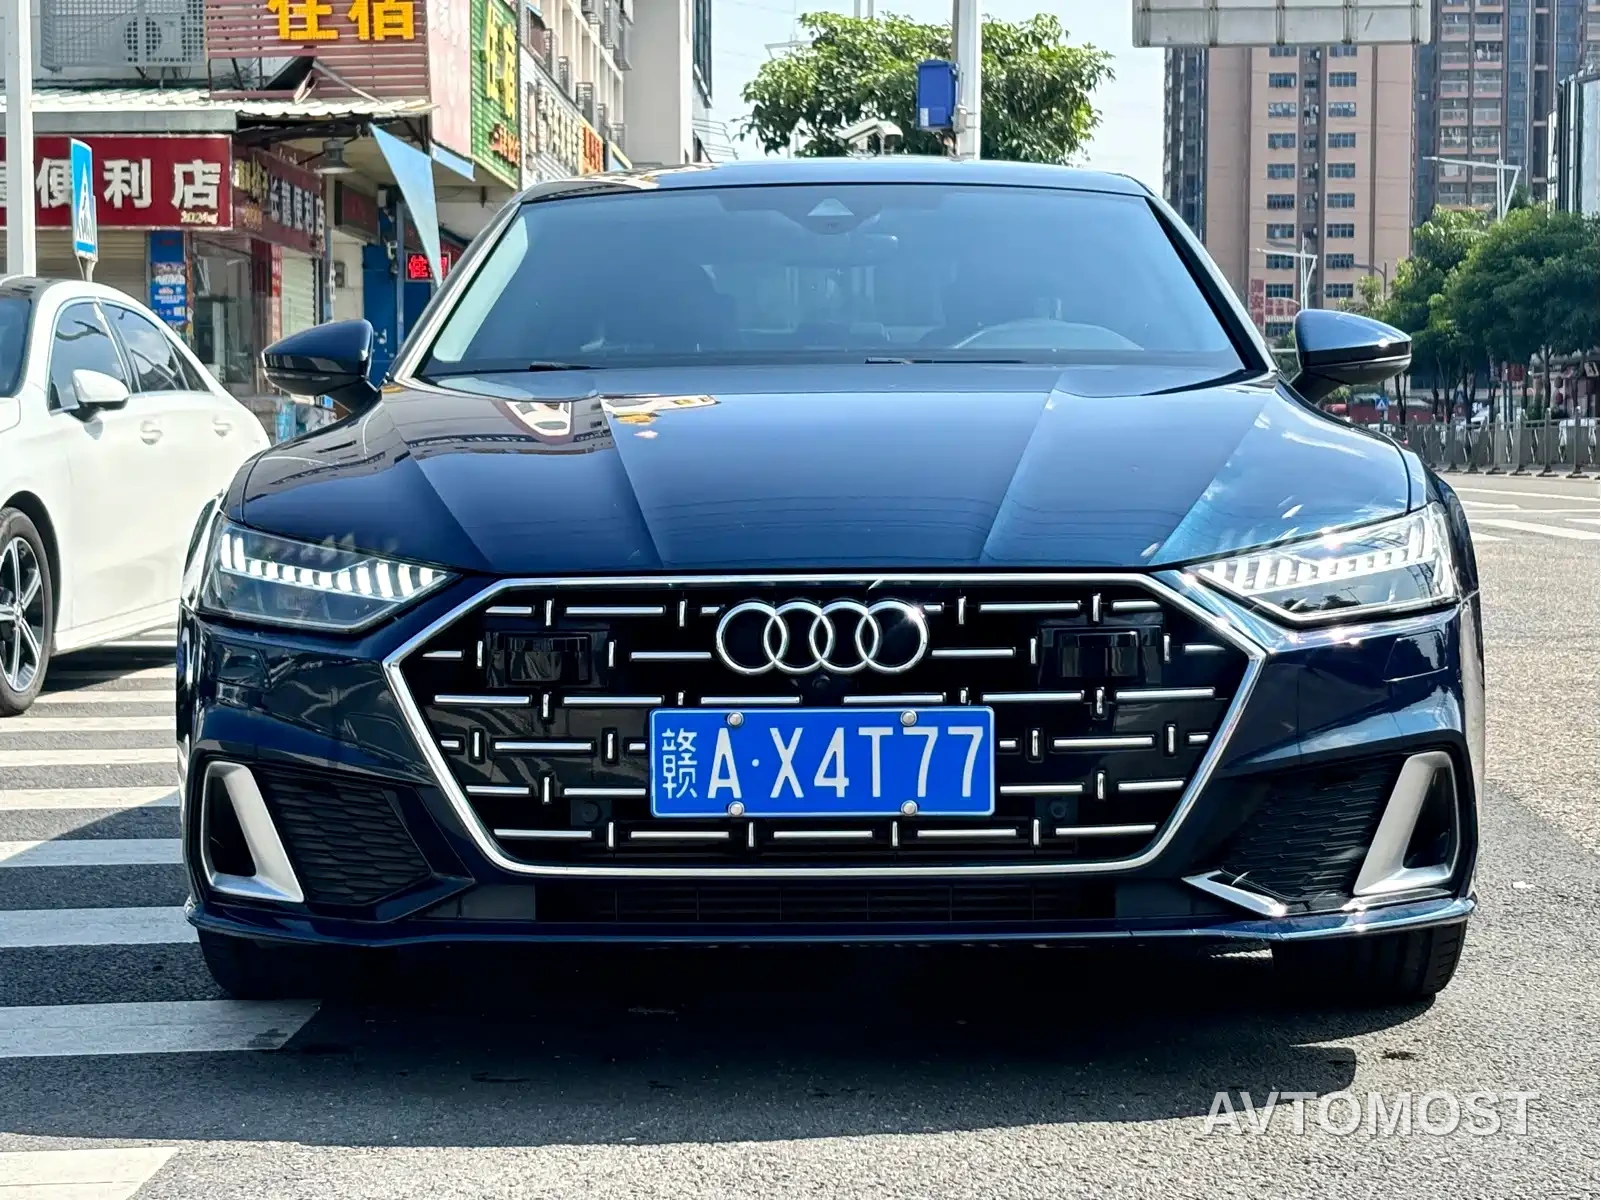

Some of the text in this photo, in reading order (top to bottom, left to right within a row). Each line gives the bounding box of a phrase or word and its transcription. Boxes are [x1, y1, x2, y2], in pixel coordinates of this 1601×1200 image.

[267, 0, 415, 41] 住宿
[0, 157, 222, 209] 便利店
[661, 726, 984, 799] 赣A·X4T77
